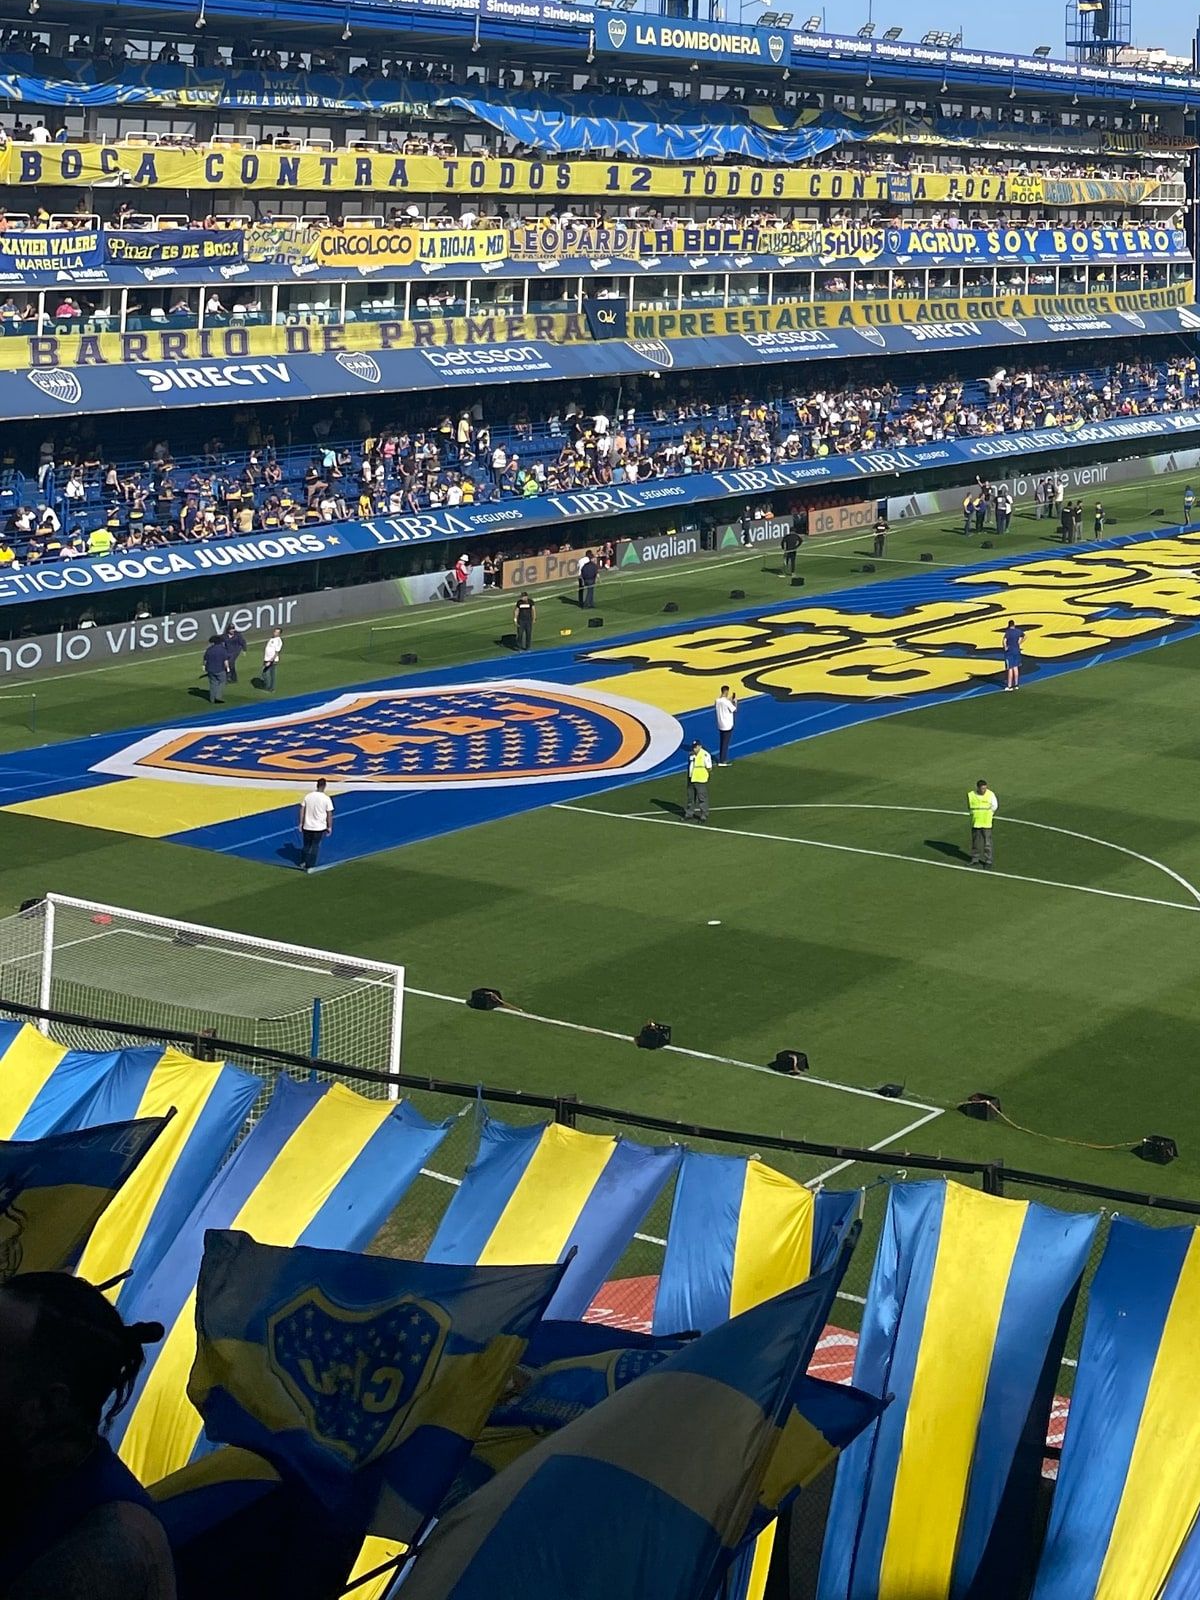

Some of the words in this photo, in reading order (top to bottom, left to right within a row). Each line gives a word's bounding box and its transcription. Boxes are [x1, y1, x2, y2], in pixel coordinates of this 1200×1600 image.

[486, 0, 540, 17] Sinteplast
[543, 6, 595, 24] Sinteplast
[636, 25, 656, 46] LA
[661, 27, 761, 56] BOMBONERA
[793, 34, 833, 50] Sinteplast
[835, 38, 872, 53] Sinteplast
[20, 149, 158, 185] BOCA
[205, 153, 409, 188] CONTRA
[443, 161, 571, 190] TODOS
[605, 166, 651, 191] 12
[683, 170, 785, 196] TODOS
[809, 173, 926, 198] CONTA
[1012, 177, 1041, 187] AZUL
[1, 237, 47, 257] XAVIER
[321, 234, 412, 256] CIRCOLOCO
[419, 236, 436, 258] LA
[440, 235, 475, 257] RIOJA
[510, 229, 637, 251] LEOPARDI
[639, 229, 674, 252] LA
[684, 229, 759, 252] BOCA
[987, 231, 1039, 253] SOY
[1053, 231, 1169, 253] BOSTERO
[15, 256, 83, 270] MARBELLA
[161, 245, 179, 260] ES
[181, 244, 199, 259] DE
[725, 305, 826, 334] ESTARE
[838, 303, 856, 327] A
[862, 303, 891, 325] TU
[967, 298, 1026, 319] BOCA
[1033, 296, 1114, 318] JUNIORS
[1115, 286, 1187, 312] QUERIDO
[28, 327, 250, 367] BARRIO
[285, 324, 347, 354] DE
[379, 312, 586, 349] PRIMERA
[740, 329, 831, 348] betsson
[904, 321, 982, 341] DIRECTV
[421, 345, 544, 367] betsson
[136, 362, 292, 393] DIRECTV
[976, 439, 1018, 456] CLUB
[1112, 419, 1162, 436] JUNIORS
[847, 451, 921, 474] LIBRA
[713, 467, 798, 493] LIBRA
[791, 467, 830, 479] SEGUROS
[1074, 464, 1109, 485] venir
[548, 488, 646, 517] LIBRA
[640, 486, 685, 500] SEGUROS
[361, 512, 476, 545] LIBRA
[469, 509, 523, 525] SEGUROS
[815, 514, 834, 531] de
[92, 551, 197, 584] BOCA
[197, 533, 327, 569] JUNIORS
[642, 536, 697, 561] avalian
[511, 562, 537, 586] de
[55, 632, 91, 663] lo
[106, 615, 200, 654] viste
[211, 598, 298, 634] venir
[258, 701, 562, 773] CABJ
